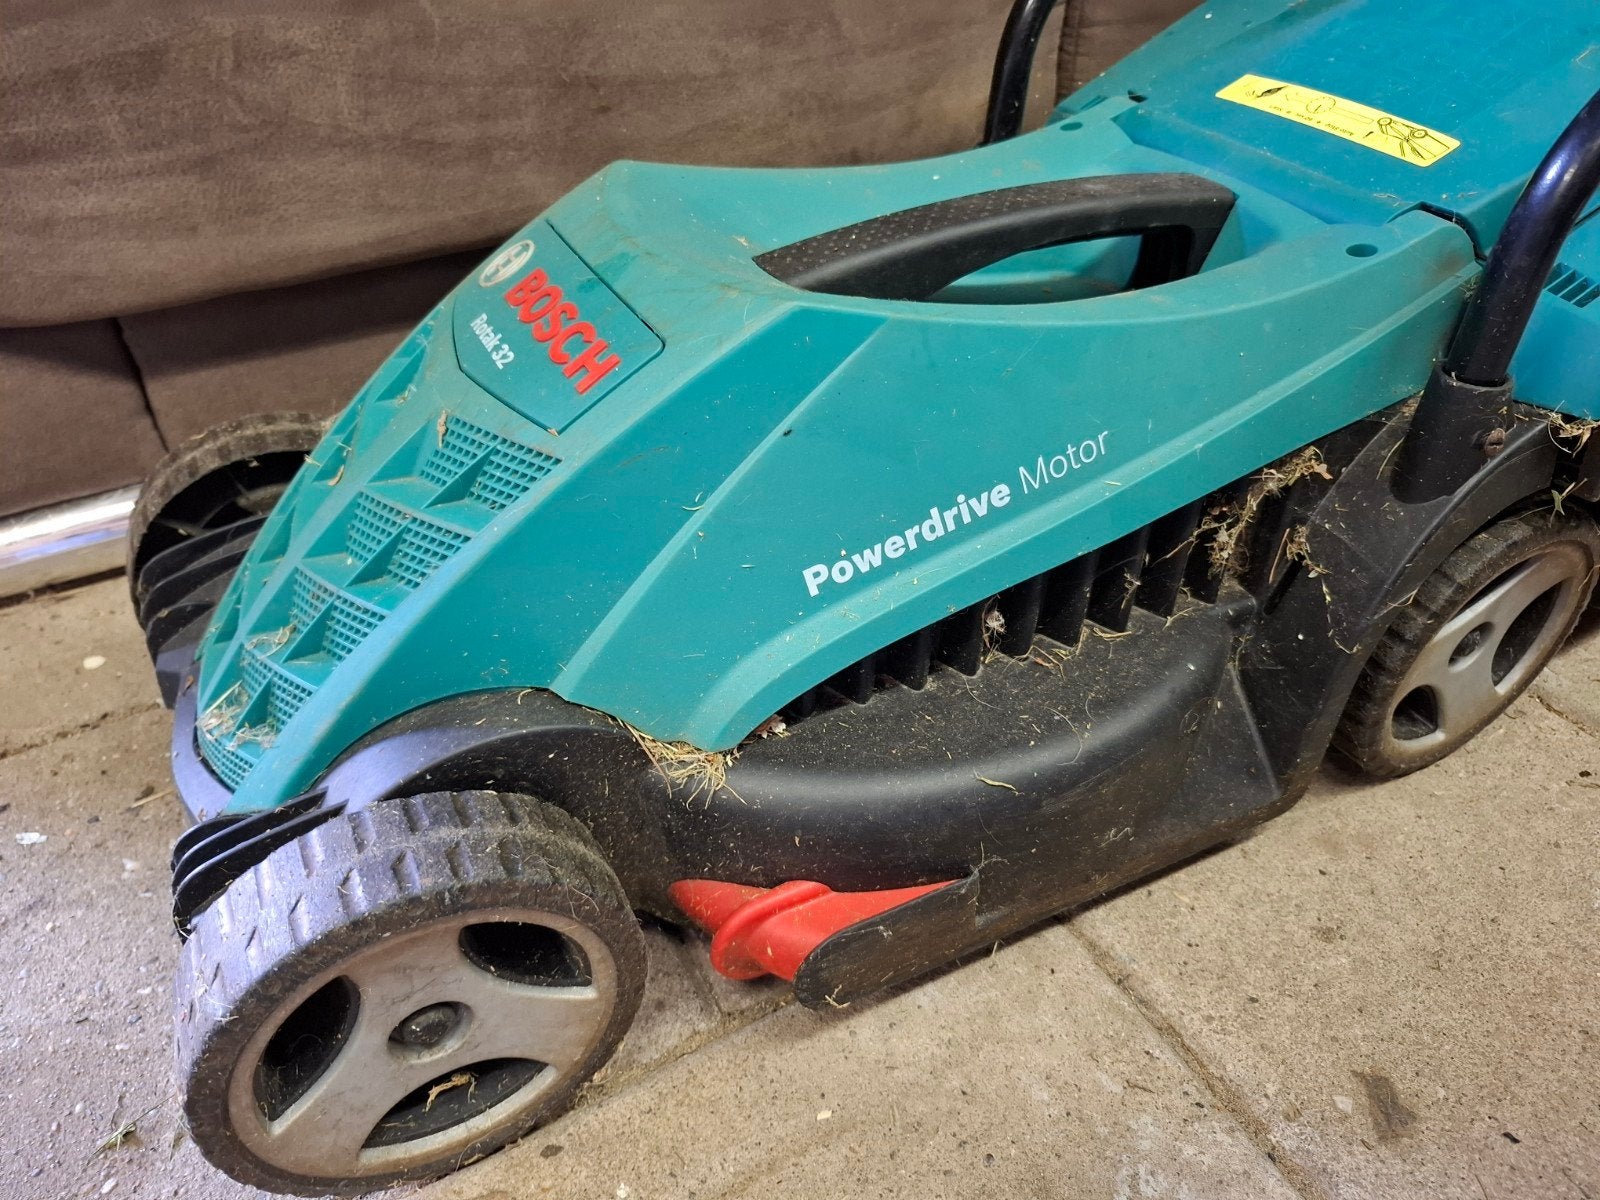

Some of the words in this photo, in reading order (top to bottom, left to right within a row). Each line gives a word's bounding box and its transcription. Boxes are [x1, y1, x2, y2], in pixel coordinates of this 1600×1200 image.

[470, 313, 502, 353] Rotak
[491, 343, 515, 370] 32
[504, 267, 621, 395] BOSCH
[802, 483, 1011, 598] Powerdrive
[1018, 430, 1109, 495] Motor
